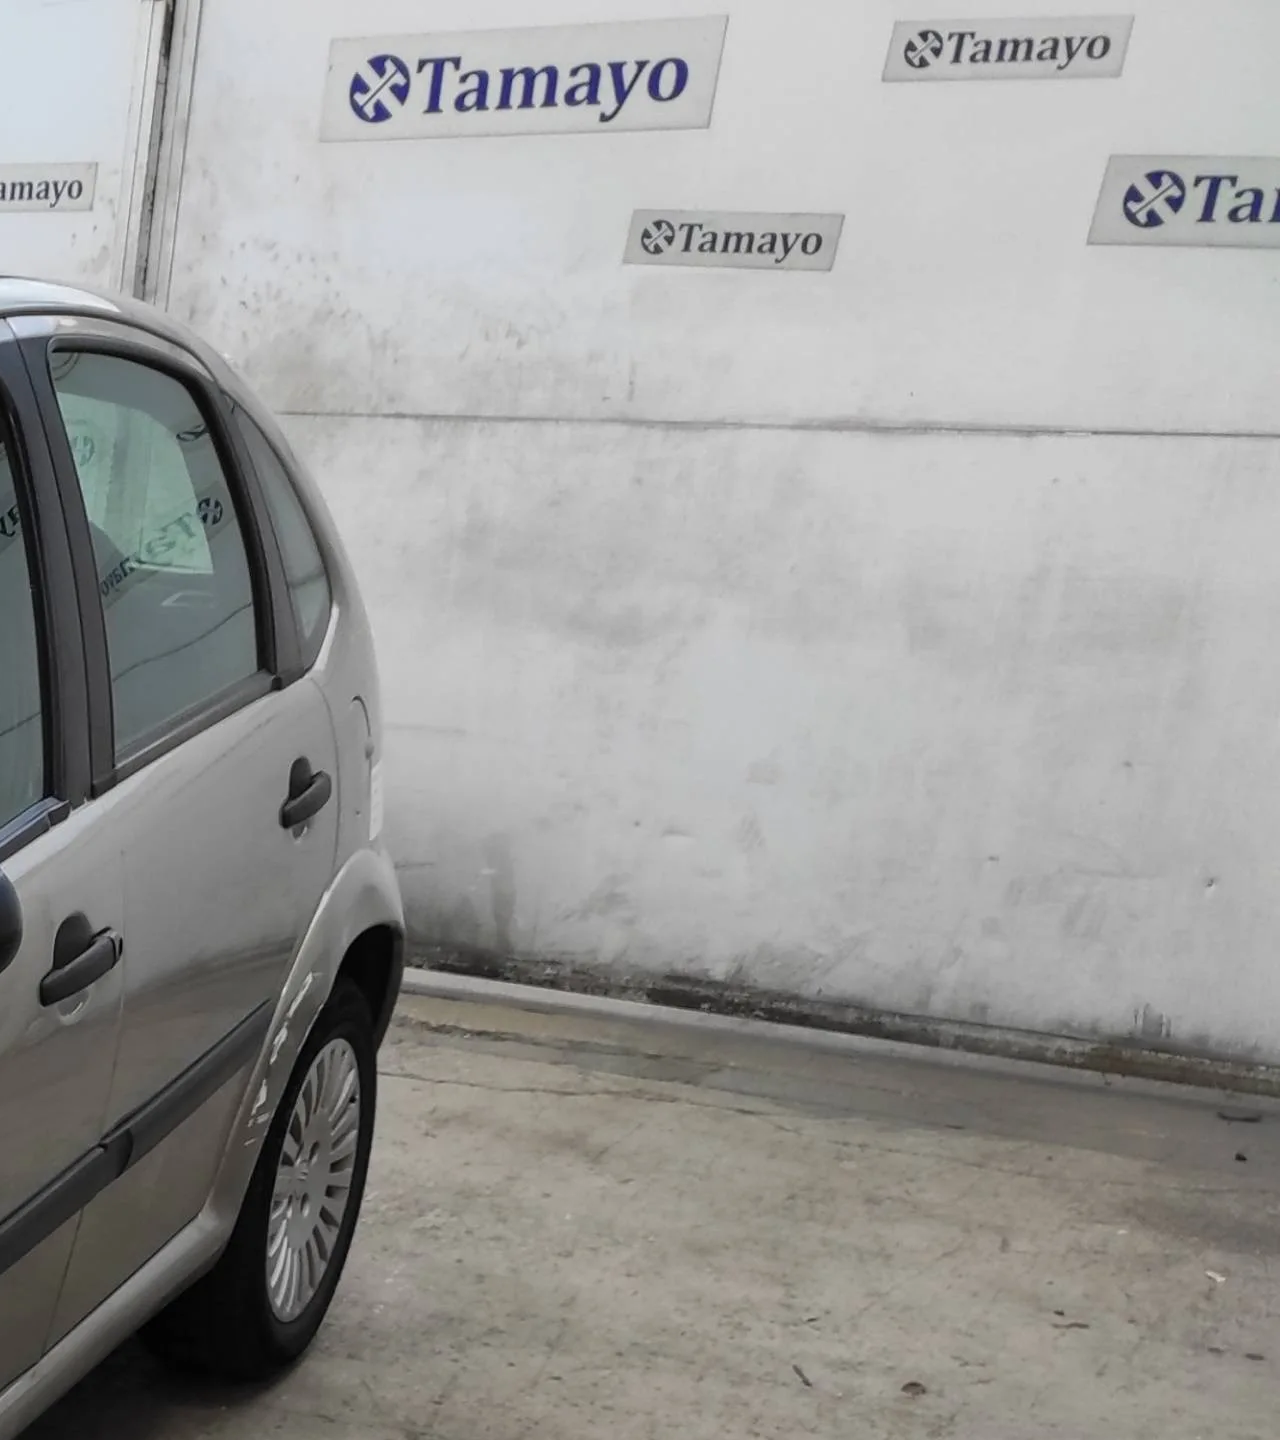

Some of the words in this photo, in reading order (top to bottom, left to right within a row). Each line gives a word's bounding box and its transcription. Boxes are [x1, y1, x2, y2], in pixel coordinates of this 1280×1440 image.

[947, 31, 1112, 71] Tamayo
[416, 55, 689, 123] Tamayo
[1192, 175, 1280, 223] Ta
[678, 222, 824, 264] Tamayo
